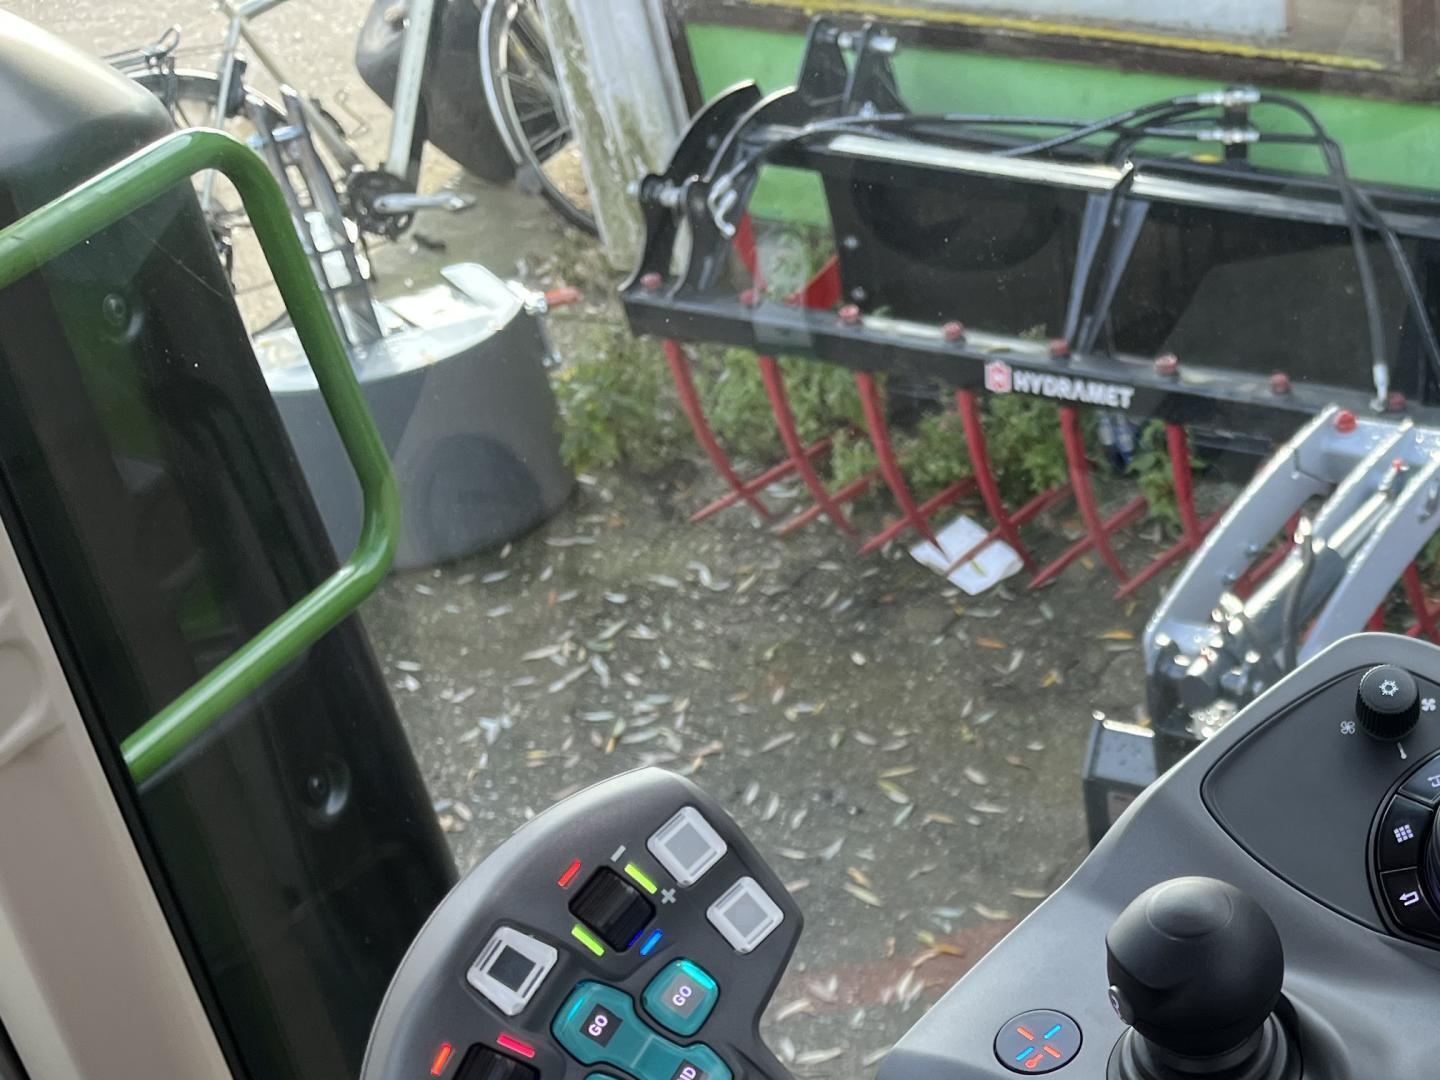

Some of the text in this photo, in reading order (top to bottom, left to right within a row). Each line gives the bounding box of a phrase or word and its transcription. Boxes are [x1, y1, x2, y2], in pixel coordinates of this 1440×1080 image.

[1012, 370, 1134, 409] HYDRAMET
[673, 986, 692, 1006] GO
[588, 1014, 608, 1036] GO
